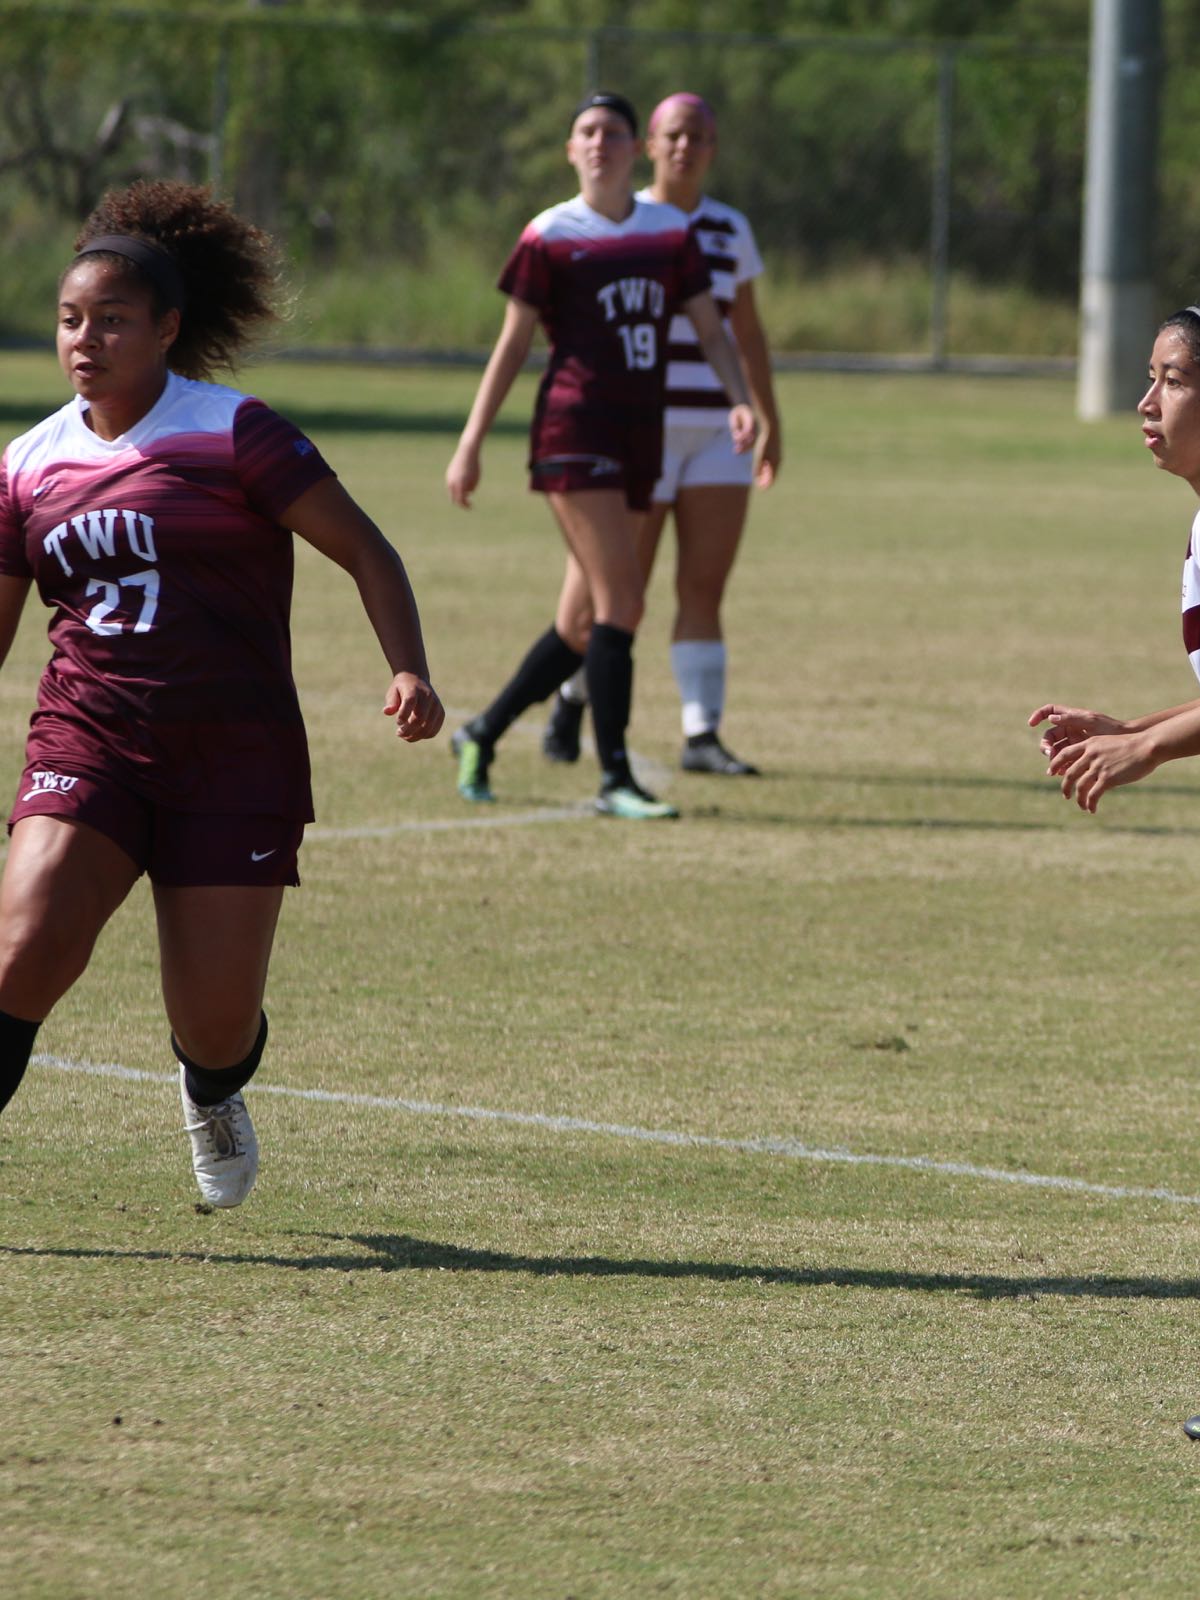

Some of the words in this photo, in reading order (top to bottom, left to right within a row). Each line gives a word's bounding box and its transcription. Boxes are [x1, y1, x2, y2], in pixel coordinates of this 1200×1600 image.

[597, 277, 665, 320] TWU
[616, 323, 657, 369] 19
[43, 508, 158, 577] TWU
[85, 569, 160, 636] 27
[31, 771, 79, 791] TWU
